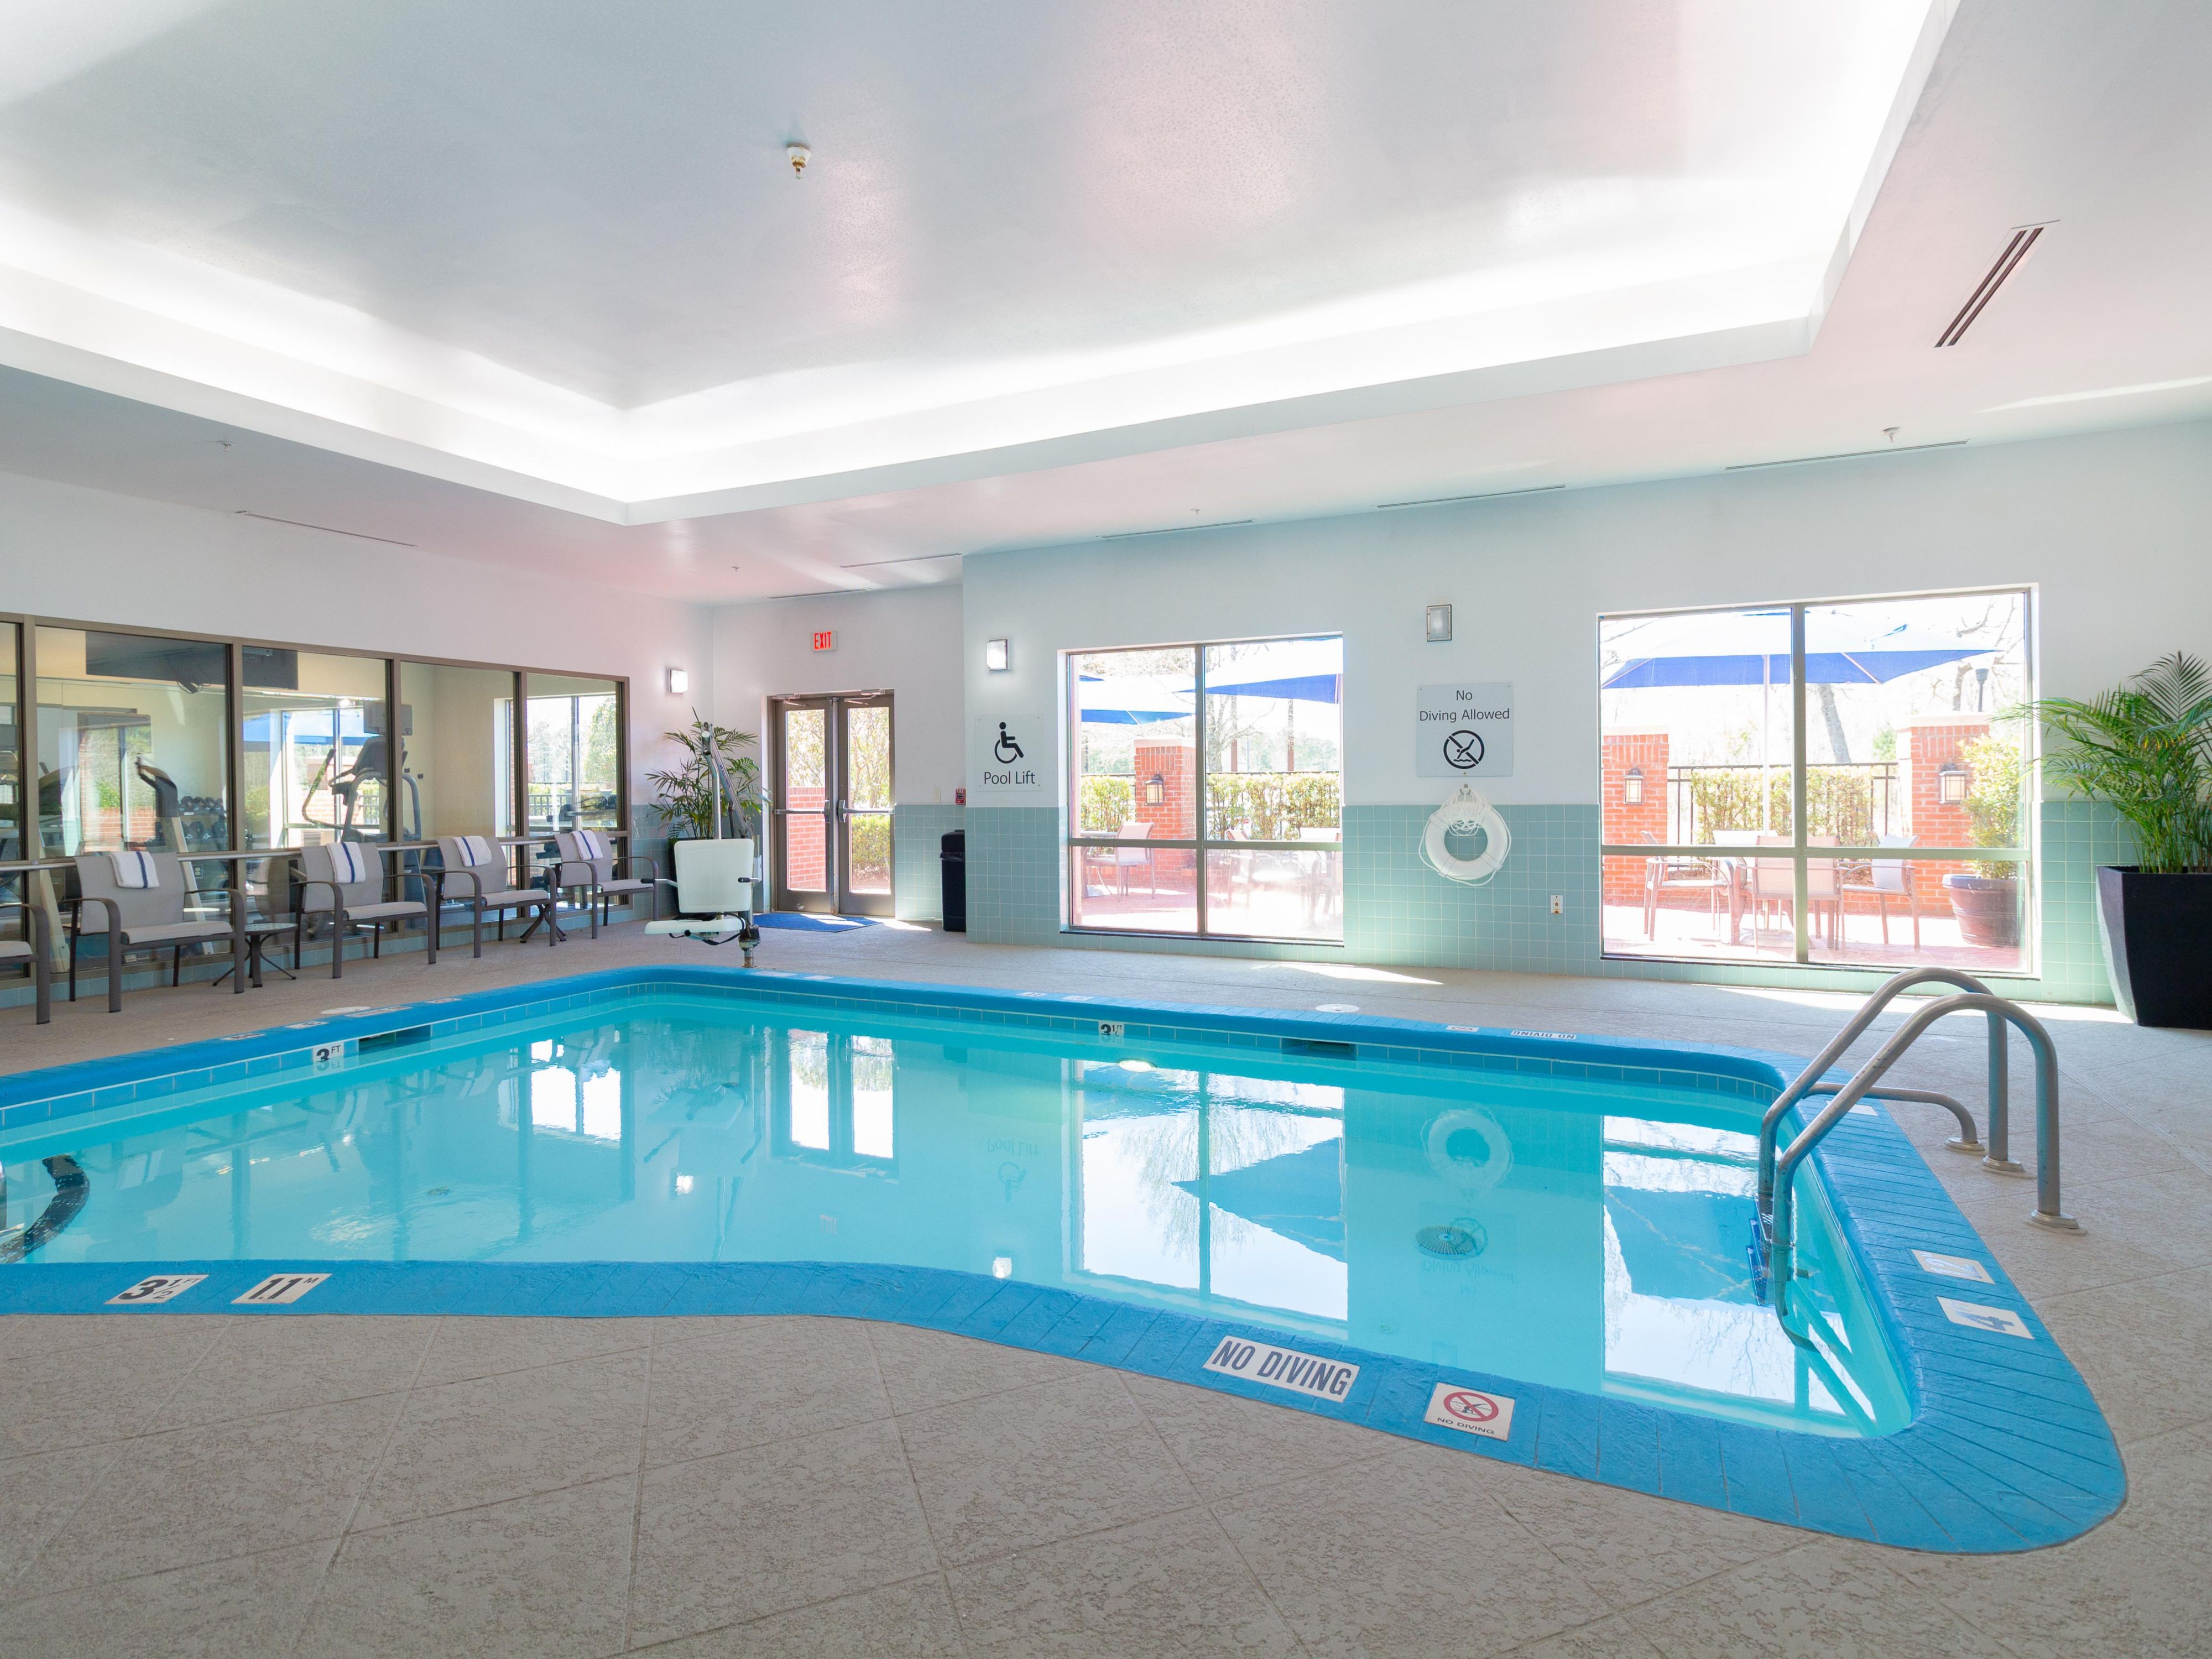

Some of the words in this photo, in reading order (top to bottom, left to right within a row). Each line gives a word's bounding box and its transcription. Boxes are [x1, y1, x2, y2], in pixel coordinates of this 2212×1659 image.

[814, 632, 832, 649] EXIT
[1456, 690, 1473, 701] No
[1420, 710, 1457, 723] Diving
[1462, 708, 1510, 720] Allowed
[984, 771, 1011, 784] Pool
[1015, 770, 1035, 784] Lift
[331, 1045, 341, 1054] FT
[1955, 1311, 2015, 1332] 4
[1211, 1340, 1256, 1370] NO
[1256, 1351, 1352, 1396] DIVING
[1437, 1417, 1454, 1425] NO
[1457, 1422, 1495, 1434] DIVING
